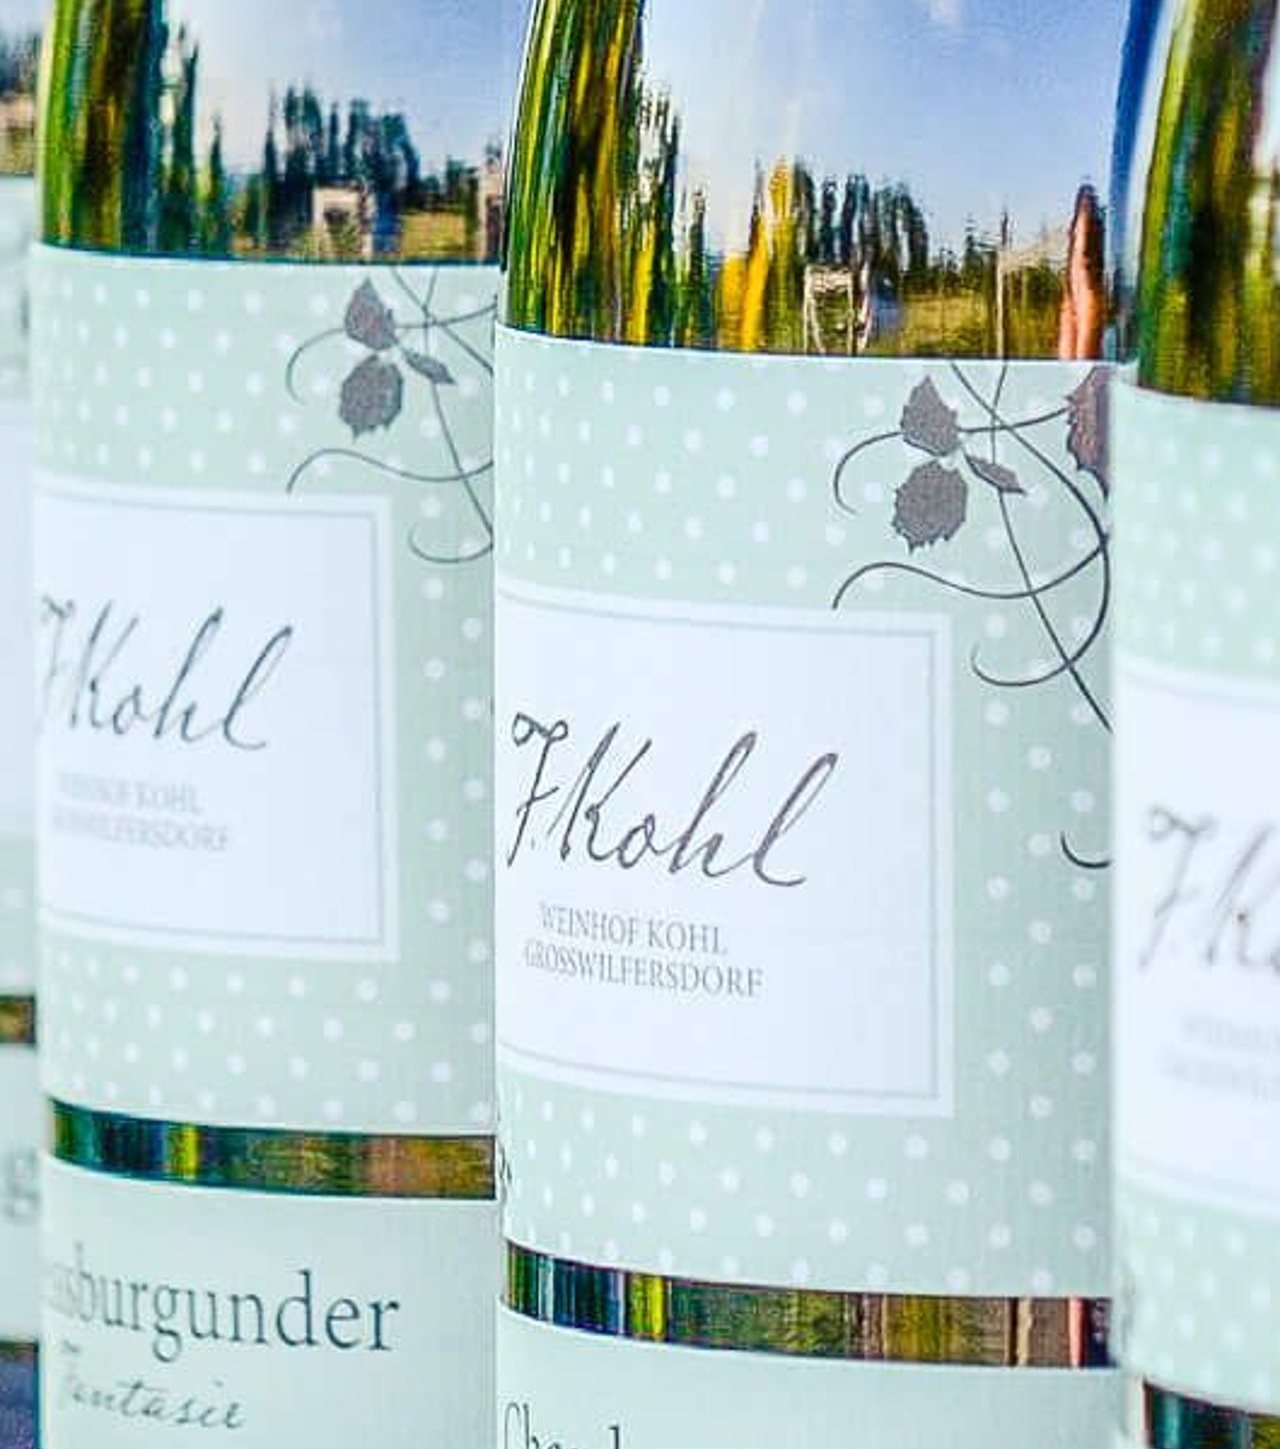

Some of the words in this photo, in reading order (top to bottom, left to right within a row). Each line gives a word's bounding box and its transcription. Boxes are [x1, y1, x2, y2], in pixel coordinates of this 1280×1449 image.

[538, 900, 640, 949] WEINHOF
[647, 917, 729, 957] KOHL
[523, 938, 766, 999] GROSSWILFERSDORF
